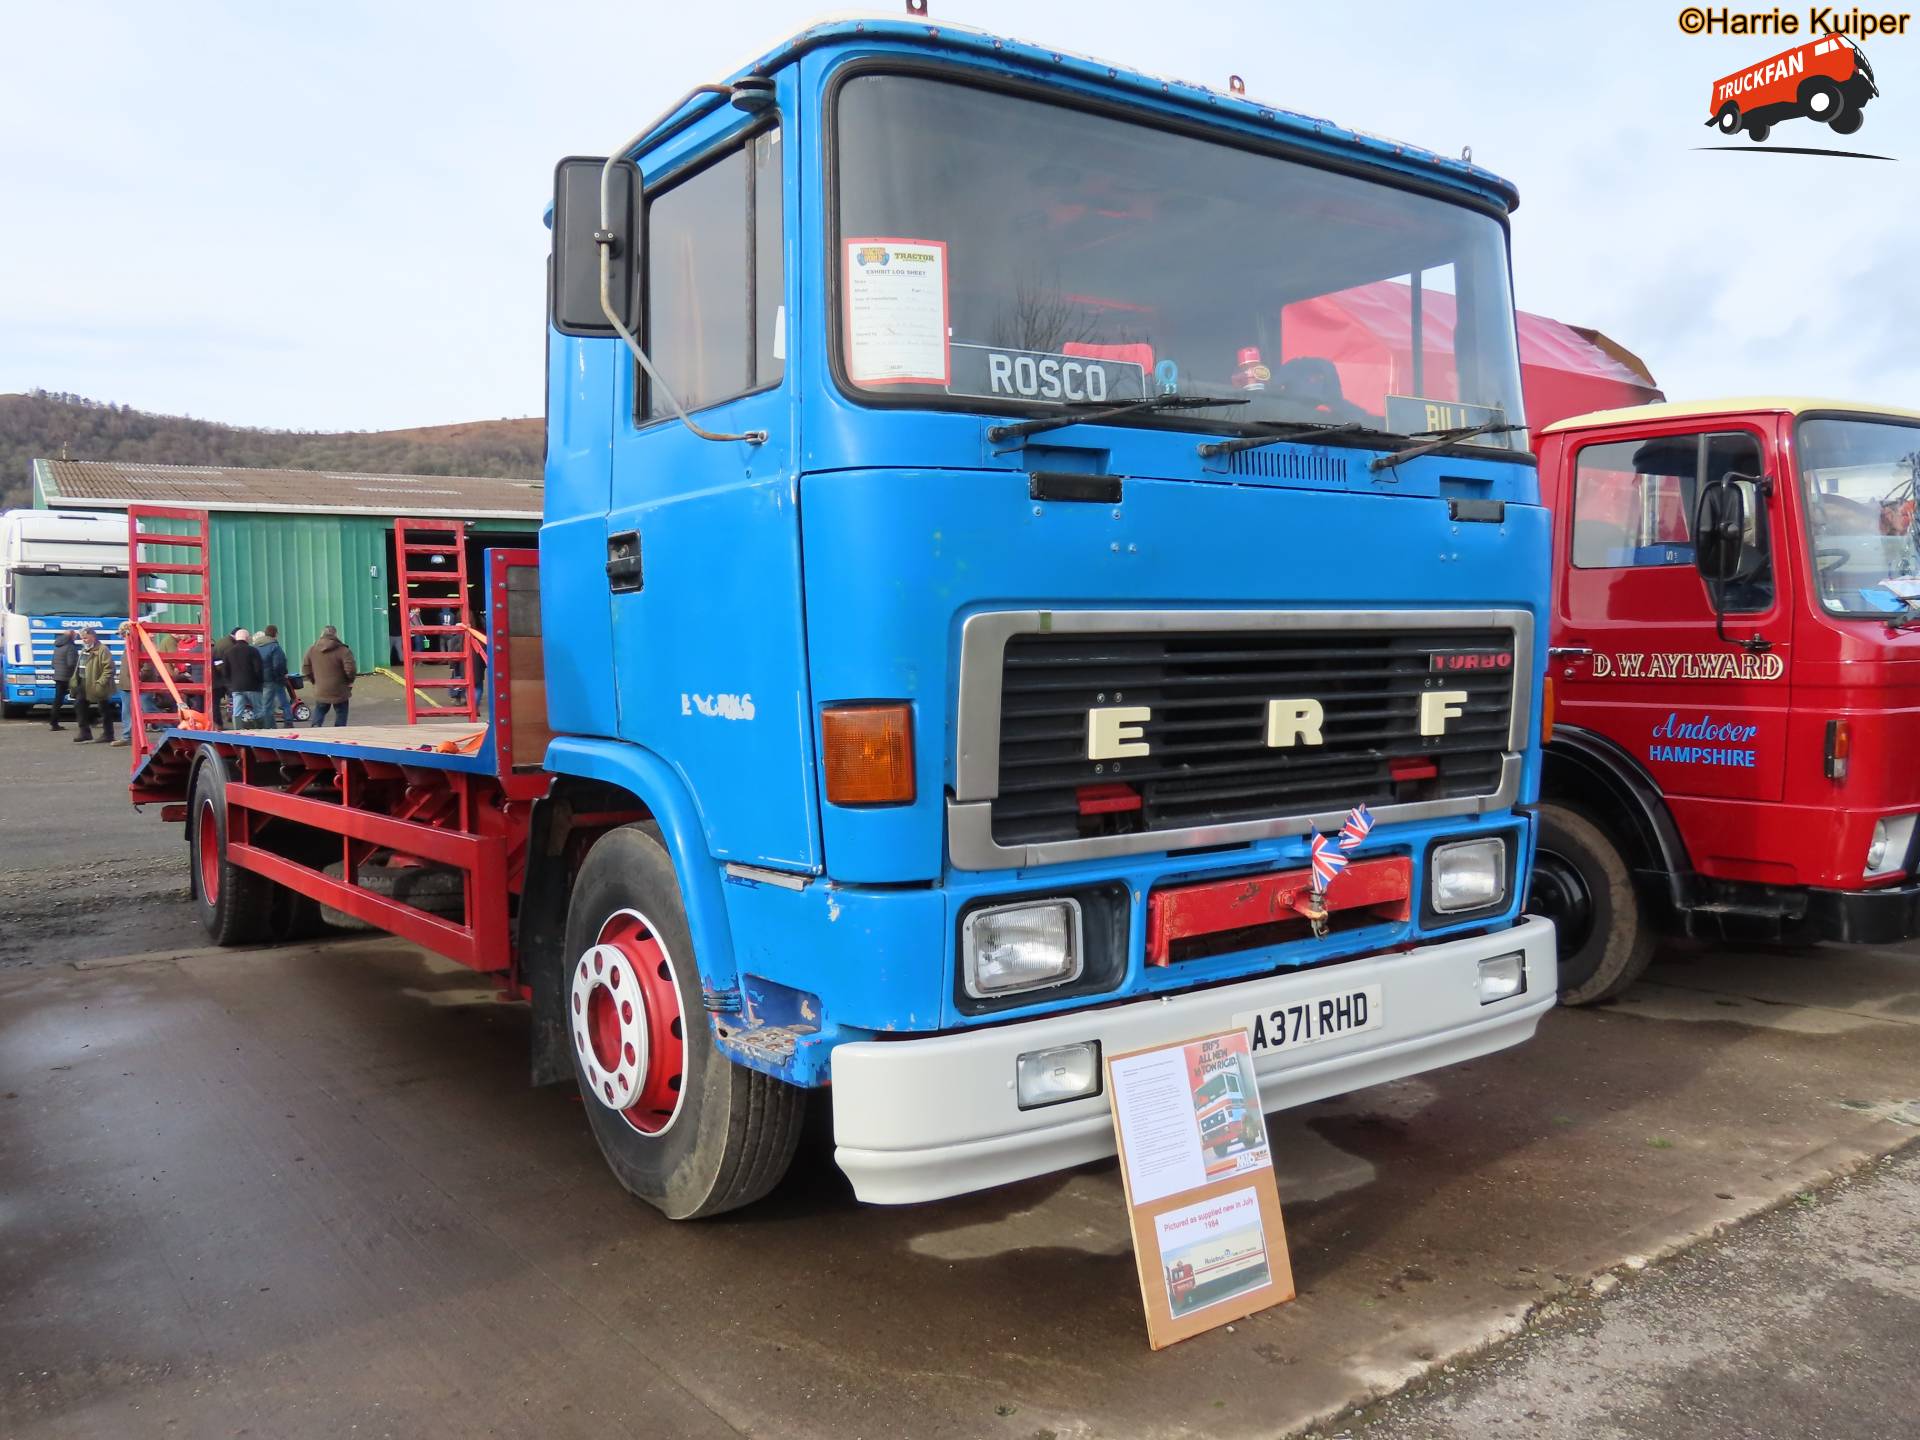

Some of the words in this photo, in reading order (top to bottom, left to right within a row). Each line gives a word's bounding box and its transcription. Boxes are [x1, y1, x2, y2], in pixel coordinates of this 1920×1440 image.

[894, 252, 935, 262] TRACTOR
[988, 353, 1107, 402] ROSCO
[61, 620, 104, 629] SCANIA
[1434, 652, 1512, 670] TURBO
[1652, 712, 1757, 743] Andover
[1649, 745, 1756, 768] HAMPSHIRE
[1252, 1003, 1311, 1052] A371
[1318, 991, 1368, 1036] RHD
[1212, 1048, 1228, 1060] NEW
[1163, 1216, 1189, 1232] Pictured
[1198, 1207, 1222, 1221] supplied
[1222, 1205, 1235, 1213] new
[1242, 1196, 1254, 1207] July
[1204, 1218, 1220, 1230] 1984
